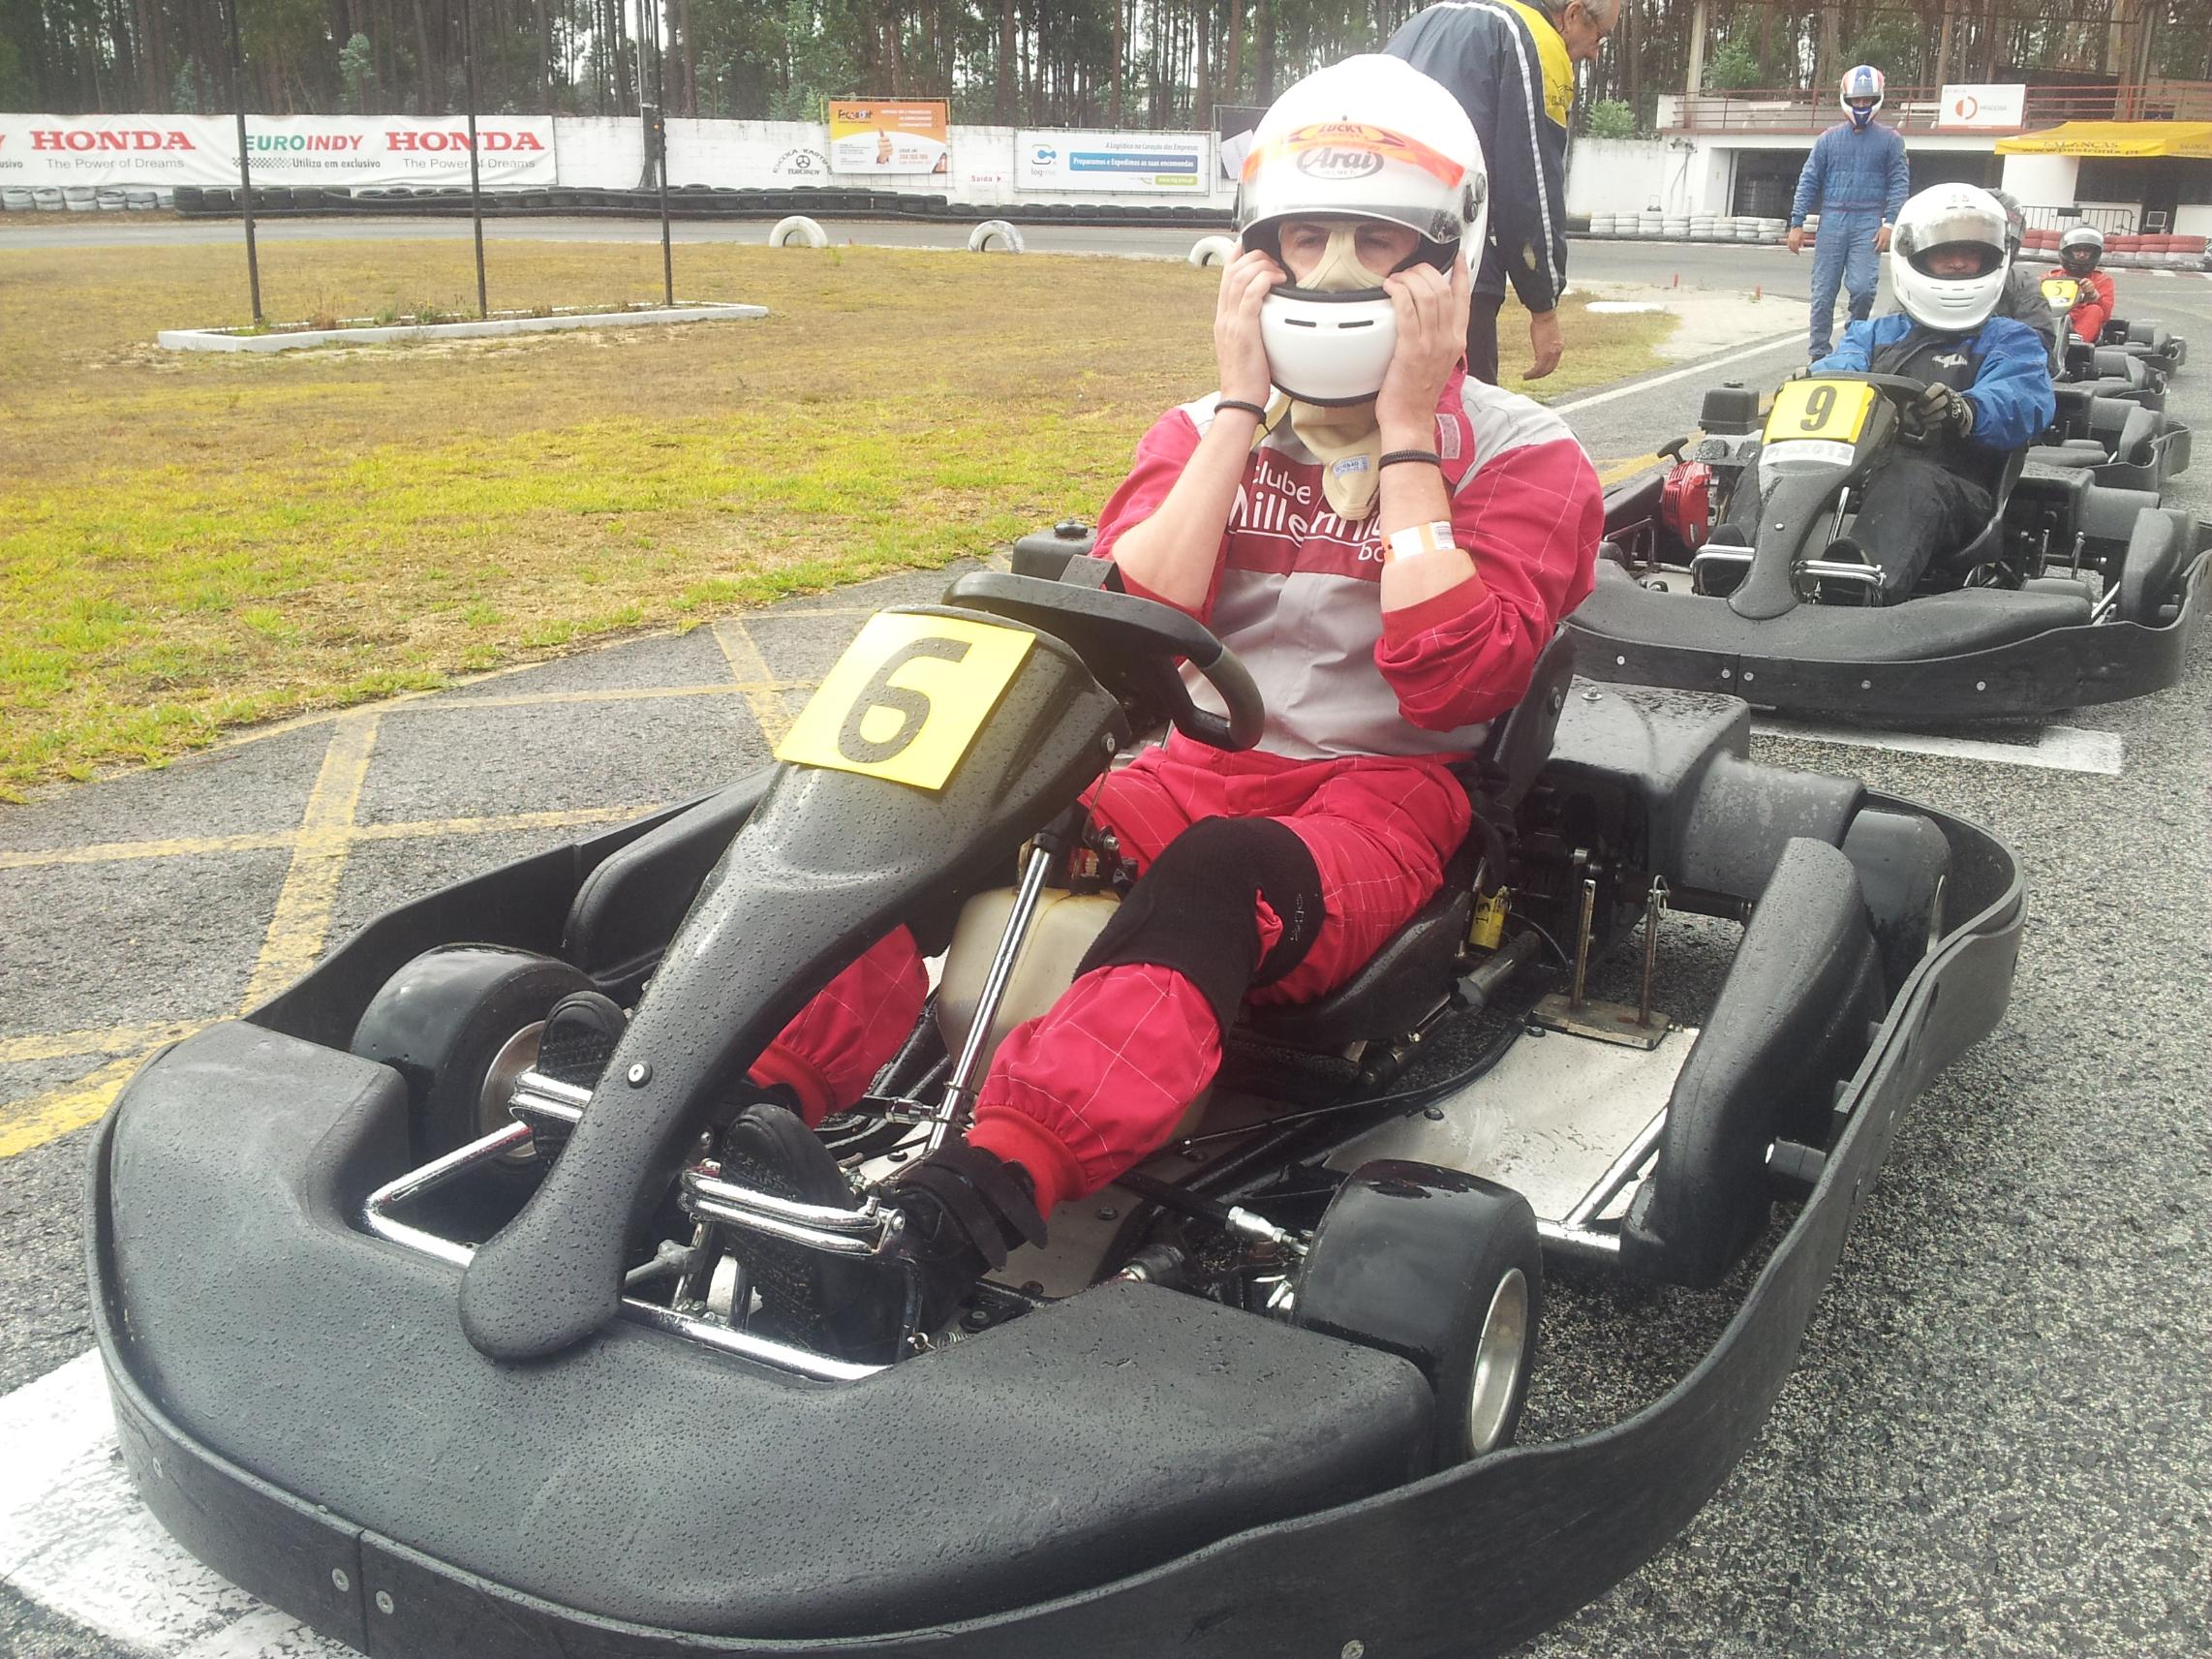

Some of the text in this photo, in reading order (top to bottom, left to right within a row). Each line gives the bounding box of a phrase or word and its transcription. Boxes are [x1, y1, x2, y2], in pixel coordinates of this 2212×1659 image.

[1318, 124, 1364, 134] LUCKY
[30, 131, 196, 151] HONDA
[245, 136, 363, 151] EUROINDY
[385, 132, 544, 151] HONDA
[46, 158, 186, 169] The Power of Dreams
[292, 158, 381, 169] Utiliza em exclusivo
[403, 159, 426, 169] The
[430, 159, 469, 169] Power
[488, 158, 537, 169] Dreams
[1073, 157, 1107, 167] Preparamos
[1112, 158, 1141, 167] Expedimos
[1160, 159, 1194, 168] encomendas
[1302, 147, 1373, 169] Arai
[1800, 384, 1837, 432] 9
[838, 636, 973, 764] 6
